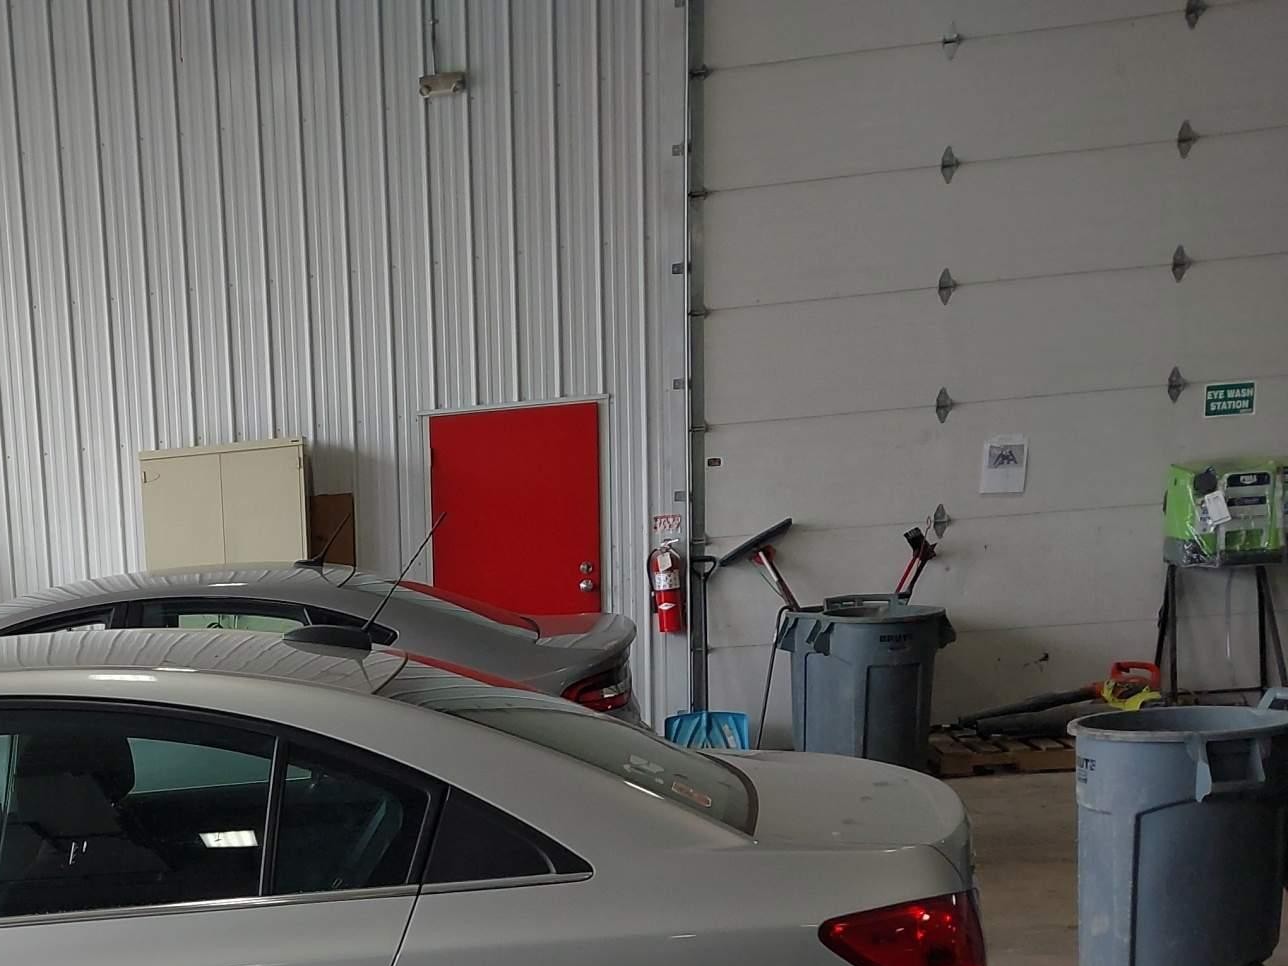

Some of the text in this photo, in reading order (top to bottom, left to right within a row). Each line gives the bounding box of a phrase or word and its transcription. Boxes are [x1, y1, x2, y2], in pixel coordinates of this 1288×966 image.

[1208, 388, 1253, 399] EYE WASH
[1210, 400, 1249, 410] STATION
